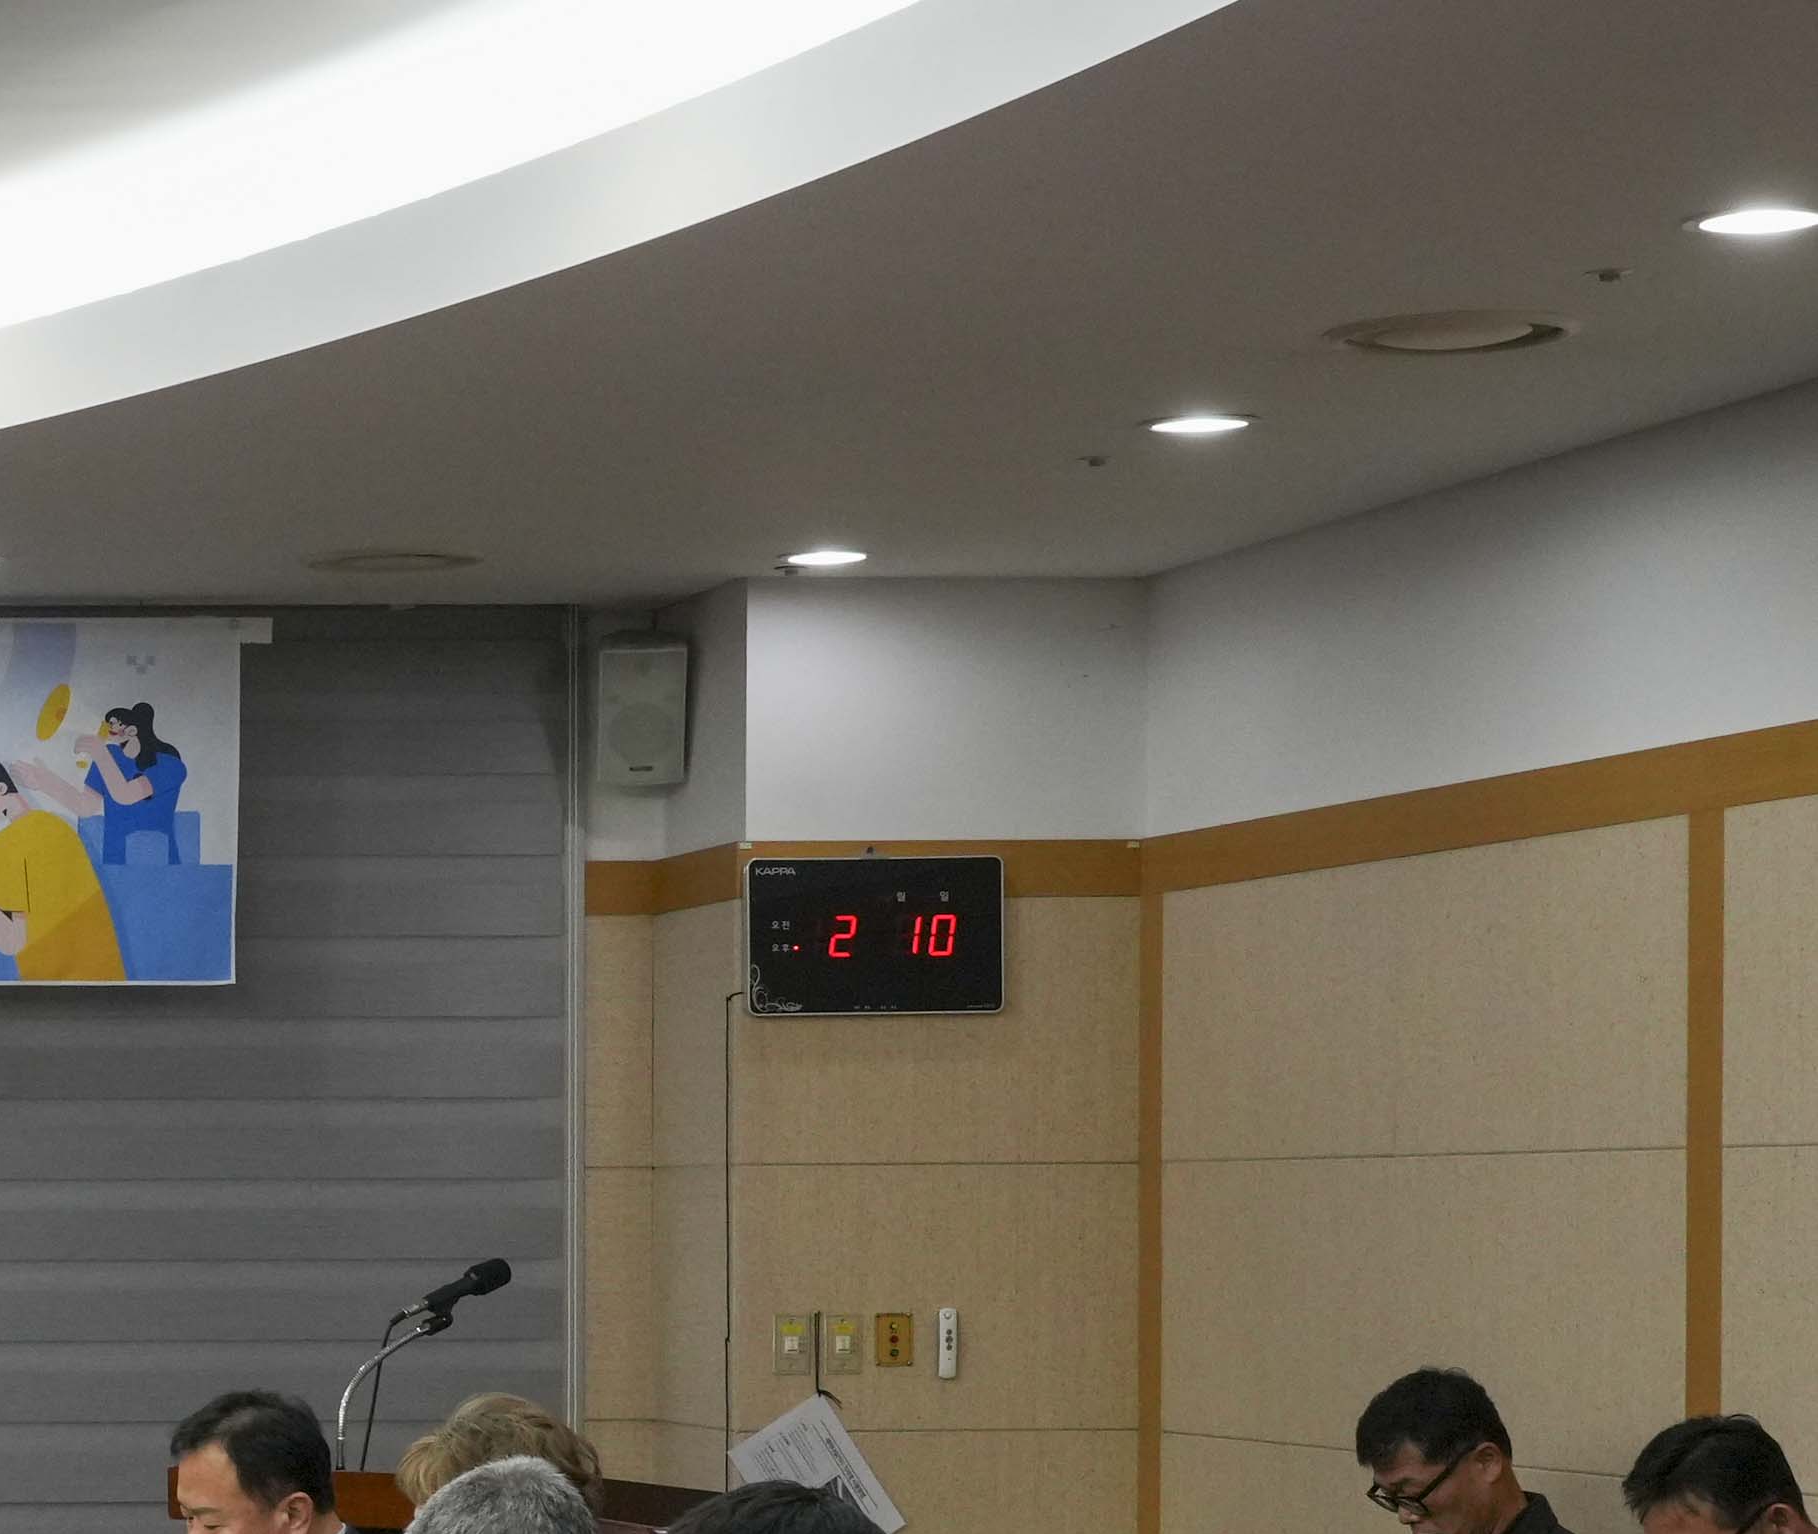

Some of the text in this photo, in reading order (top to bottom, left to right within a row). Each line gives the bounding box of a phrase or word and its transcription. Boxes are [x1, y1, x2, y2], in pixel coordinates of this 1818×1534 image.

[755, 866, 797, 877] KAPPA
[828, 913, 958, 959] 2 10
